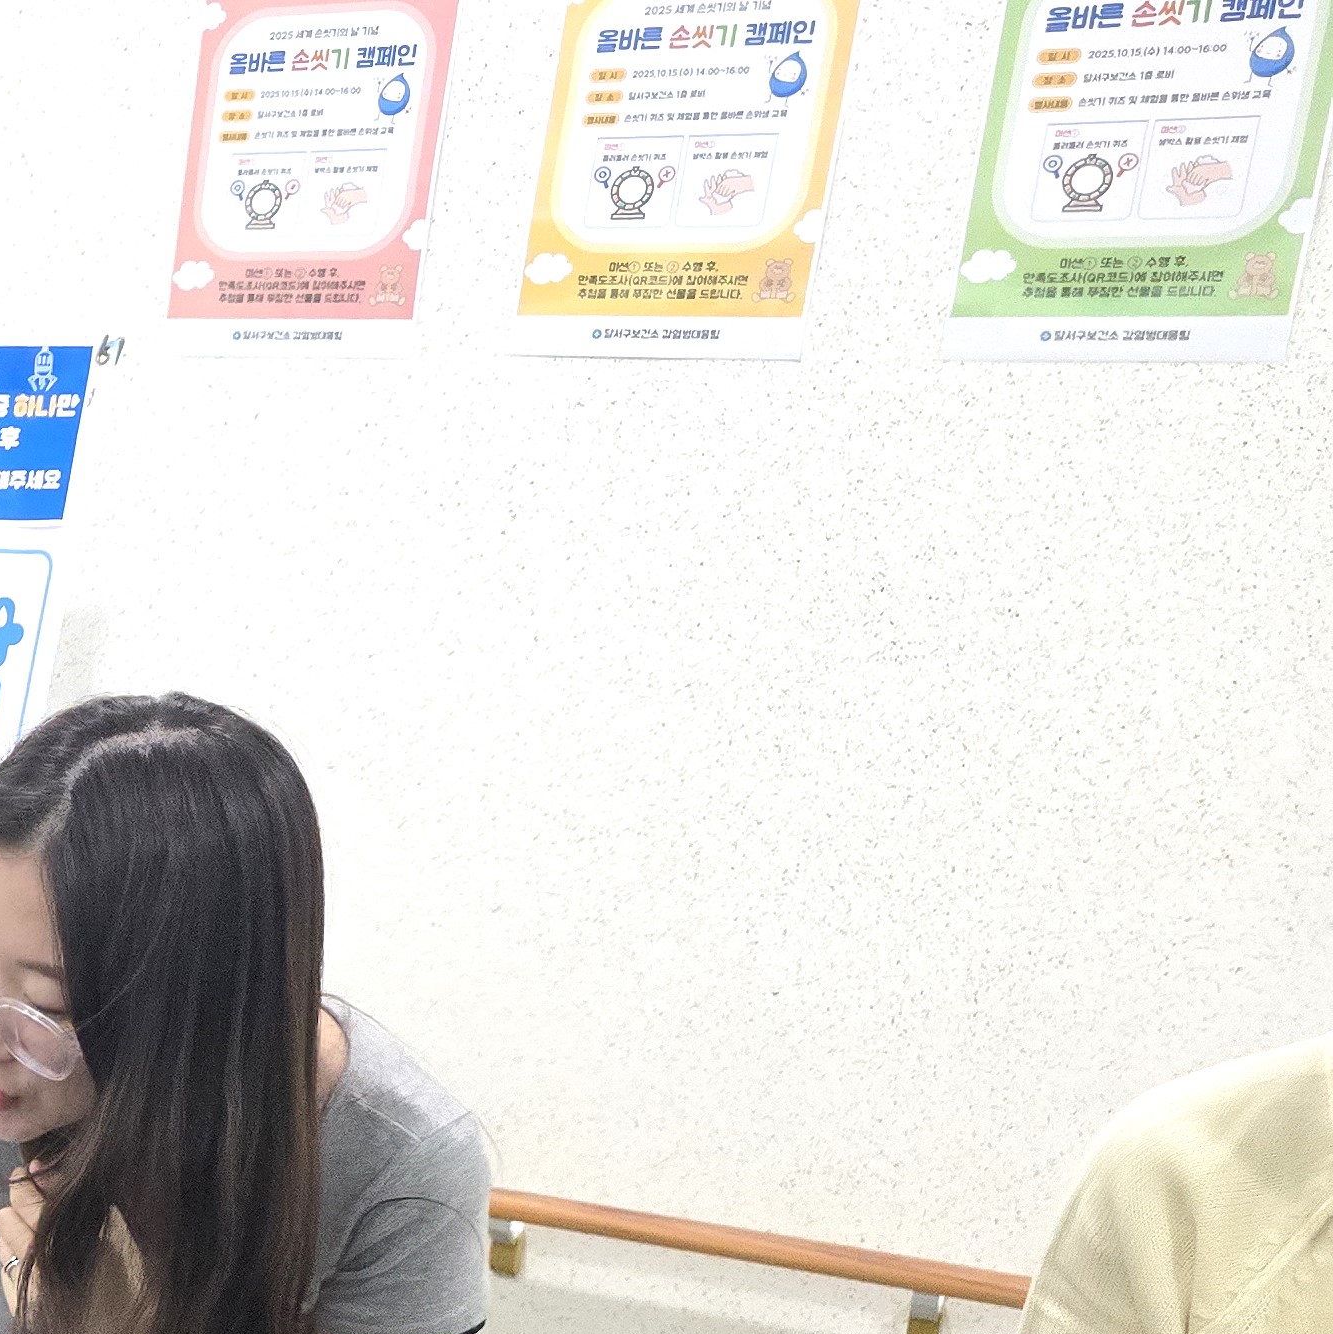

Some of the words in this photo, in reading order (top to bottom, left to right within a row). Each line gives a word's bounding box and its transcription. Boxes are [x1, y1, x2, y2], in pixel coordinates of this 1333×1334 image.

[645, 5, 672, 16] 2025
[1045, 3, 1124, 32] 올바른
[1131, 0, 1213, 27] 손씻기
[1219, 0, 1304, 22] 캠페인
[270, 30, 293, 40] 2025
[597, 27, 663, 53] 올바른
[669, 24, 737, 49] 손씻기
[745, 20, 815, 46] 캠페인
[229, 50, 285, 75] 올바른
[291, 47, 350, 72] 손씻기
[356, 43, 417, 69] 캠페인
[13, 393, 81, 418] 하나만
